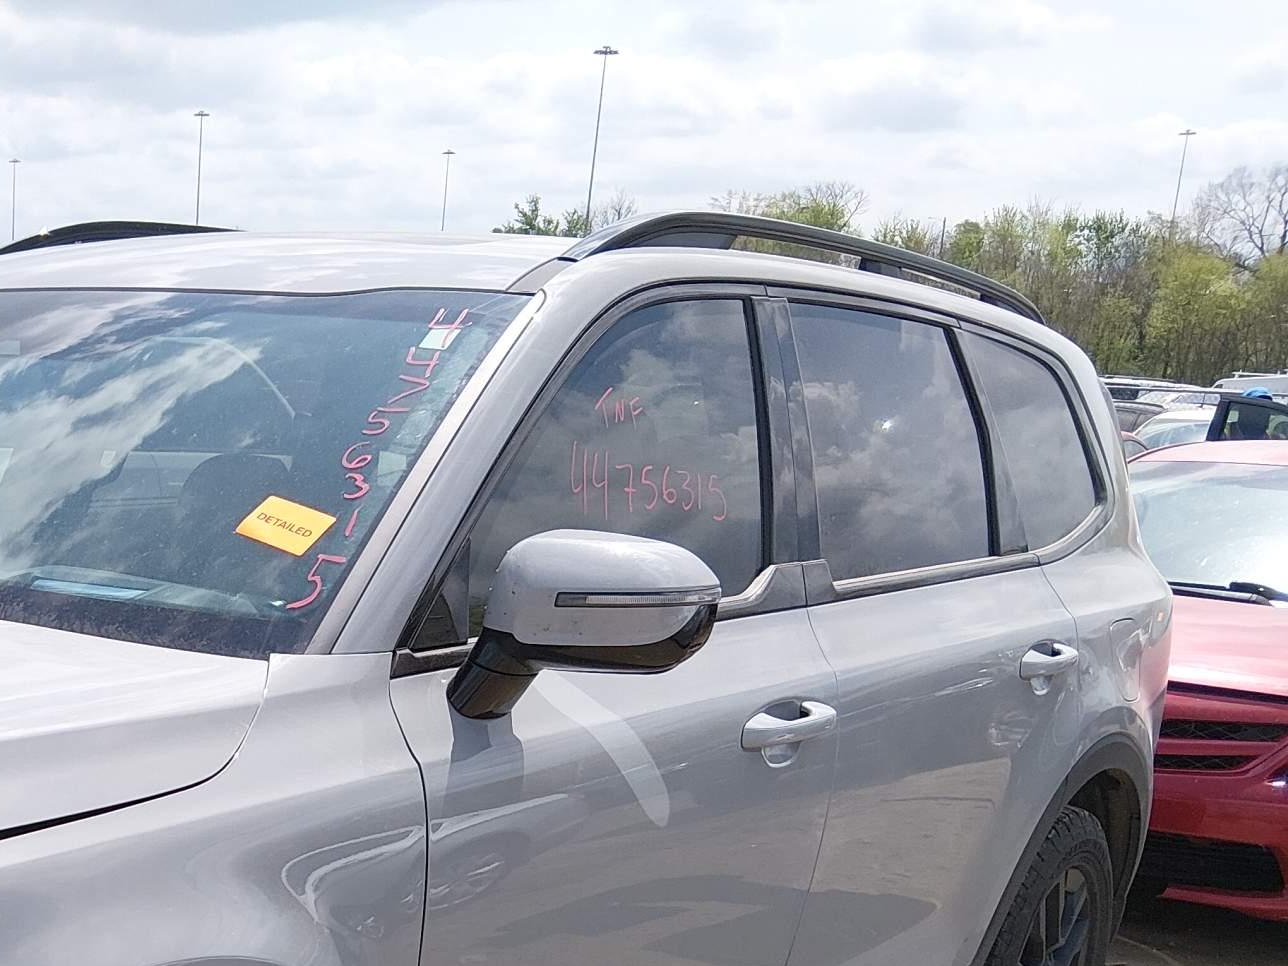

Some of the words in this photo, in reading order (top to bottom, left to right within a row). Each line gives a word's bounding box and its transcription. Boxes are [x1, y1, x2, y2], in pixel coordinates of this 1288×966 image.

[594, 387, 644, 430] TNF
[570, 440, 729, 521] 44756315
[256, 512, 313, 538] DETAILED
